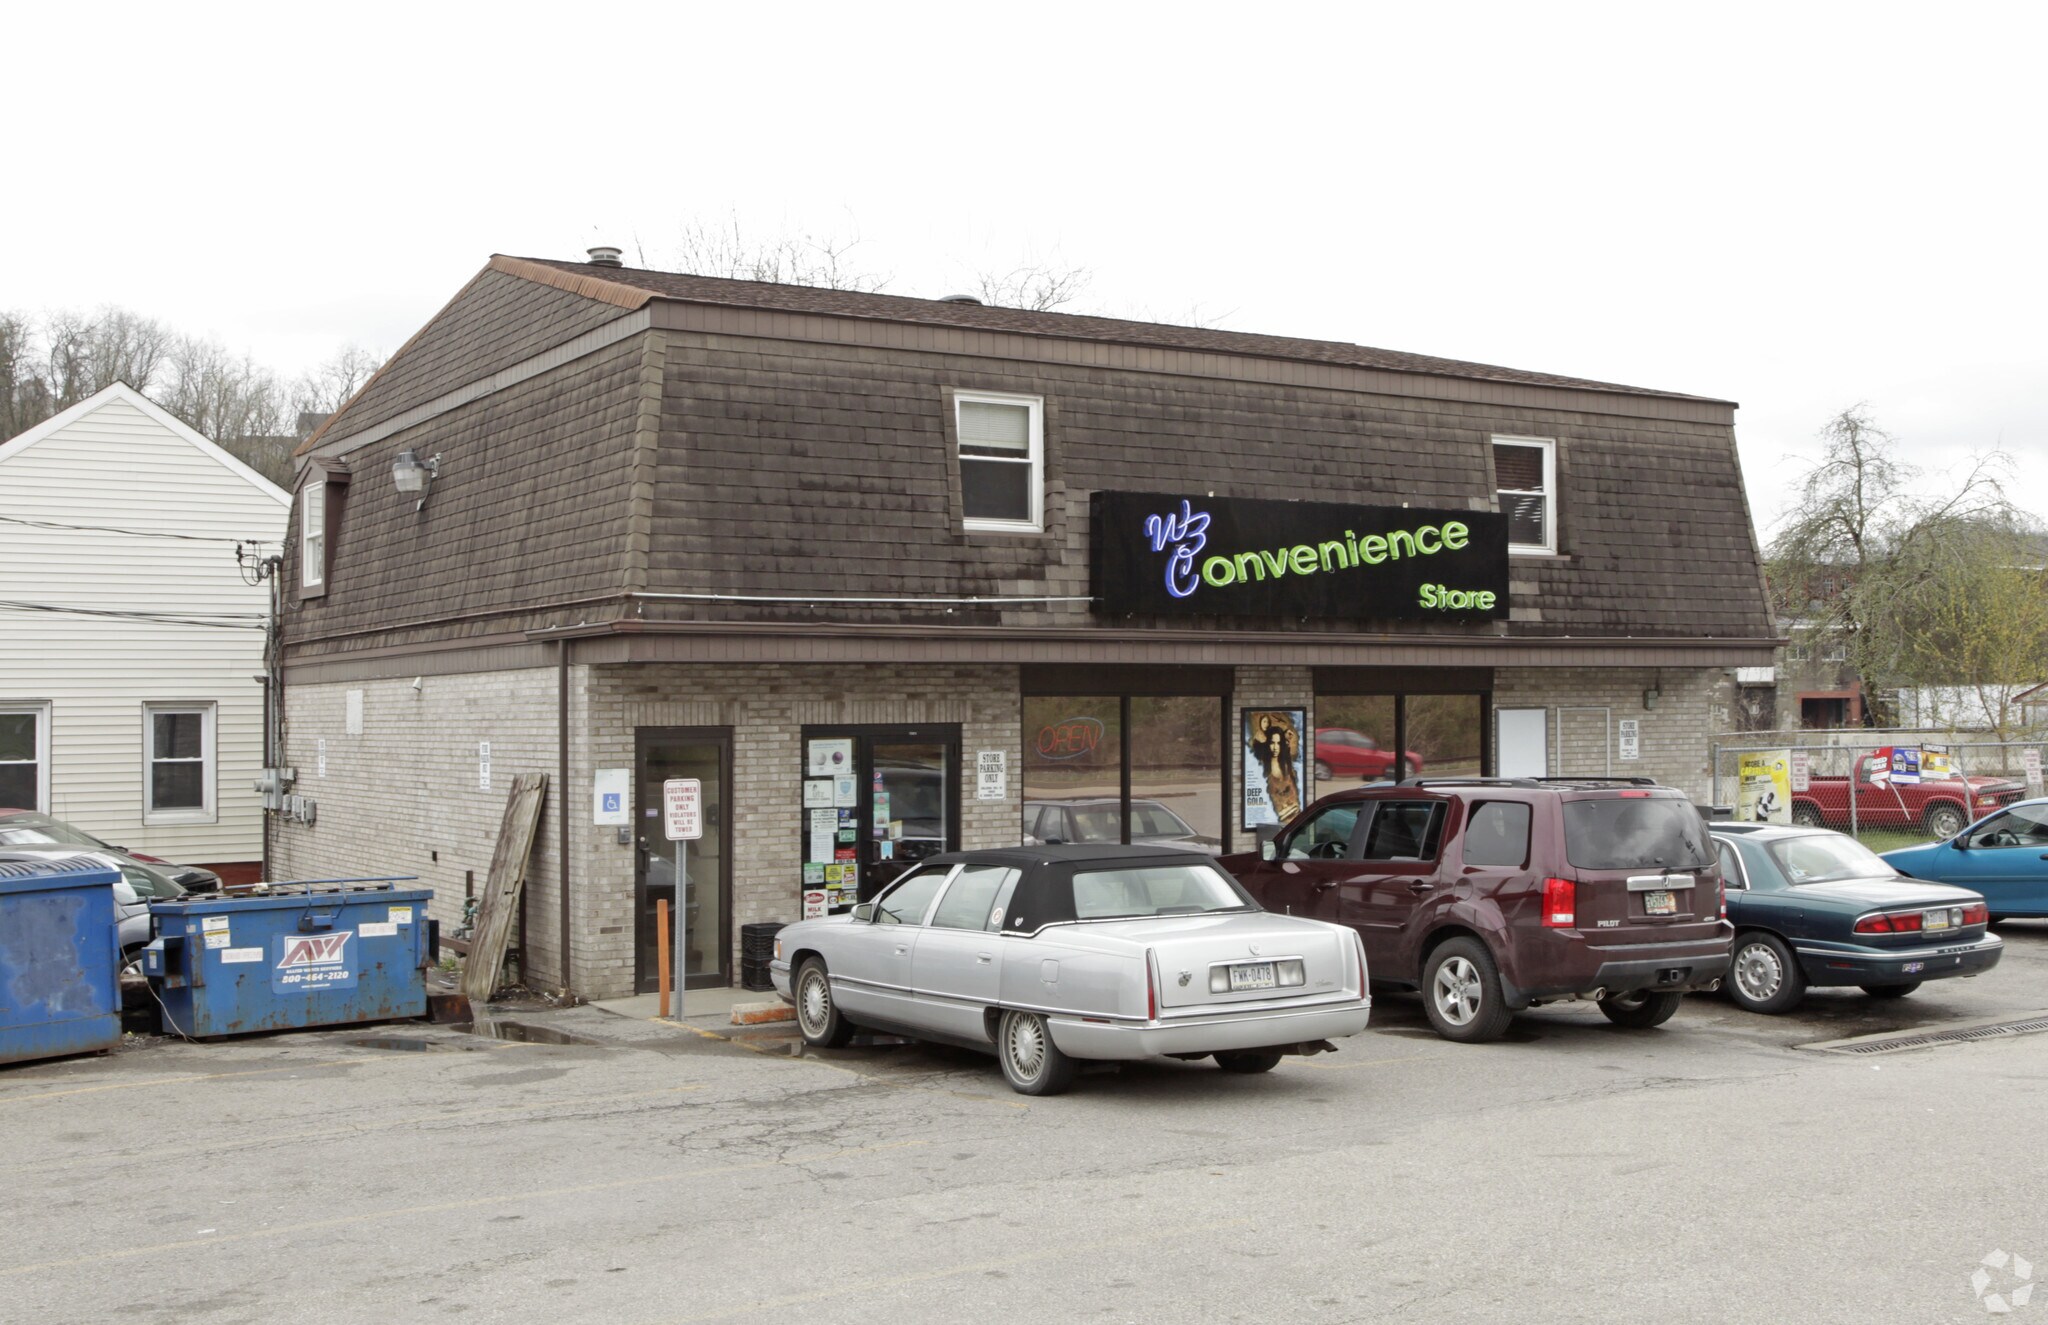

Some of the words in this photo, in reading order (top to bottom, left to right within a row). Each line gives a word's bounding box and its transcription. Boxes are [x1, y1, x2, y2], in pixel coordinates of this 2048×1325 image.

[1419, 583, 1496, 610] Store
[1039, 725, 1099, 752] OPEN
[983, 753, 1000, 763] STORE
[980, 763, 1003, 773] PARKING
[985, 773, 999, 783] ONLY
[666, 786, 697, 794] CUSTOMER
[1246, 788, 1262, 797] DEEP
[675, 803, 689, 811] ONLY
[1246, 798, 1264, 806] GOLD
[281, 971, 349, 984] 800-464-2120
